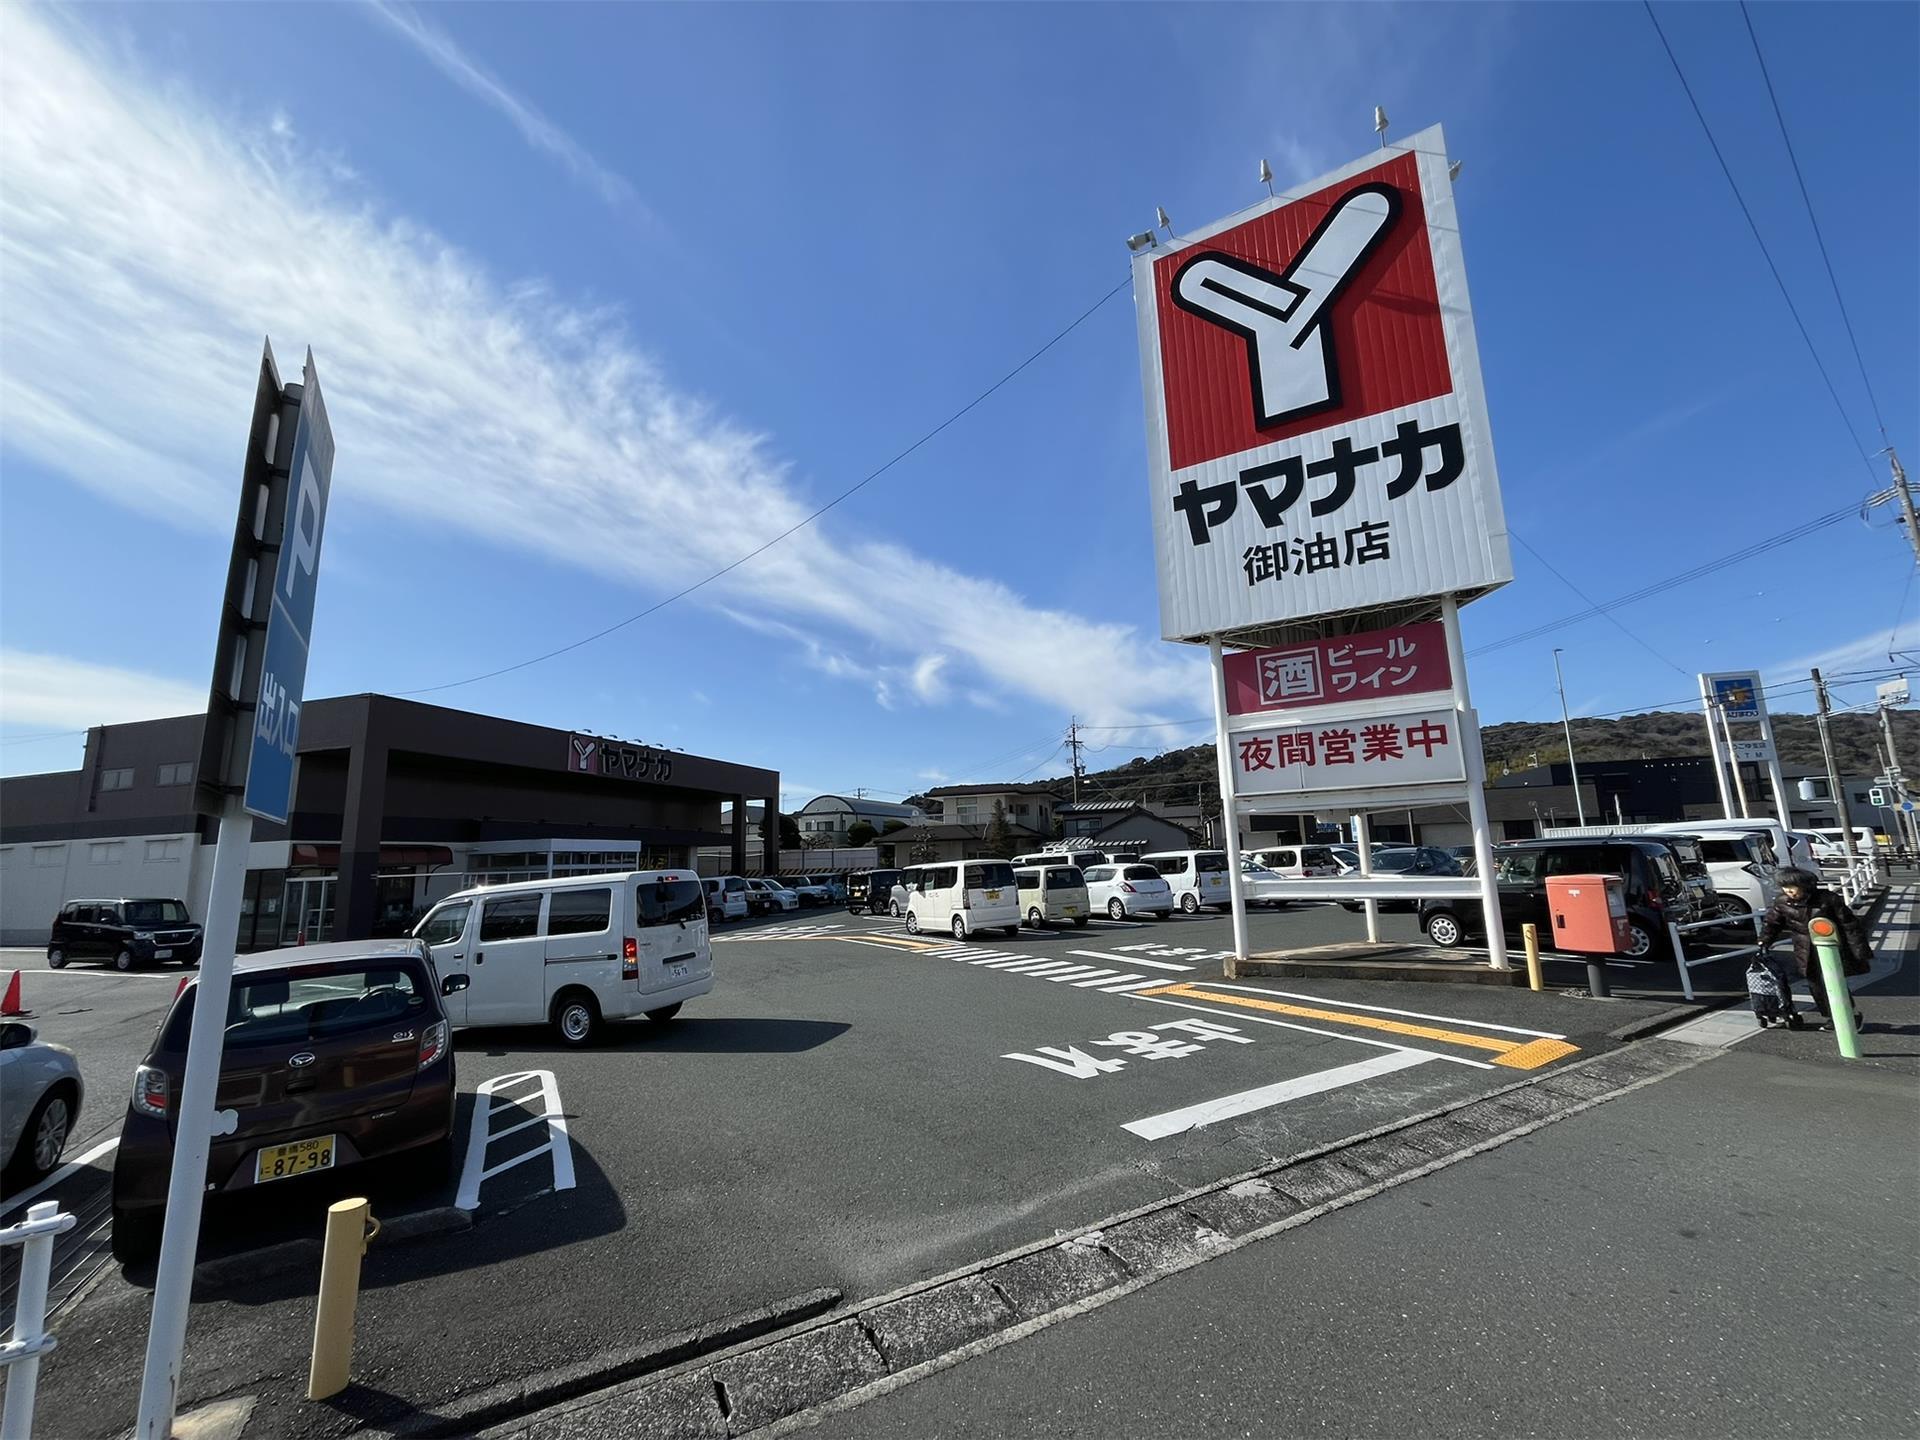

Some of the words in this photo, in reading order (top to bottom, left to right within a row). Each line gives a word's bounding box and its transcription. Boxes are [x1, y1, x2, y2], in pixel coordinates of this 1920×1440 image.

[1173, 420, 1466, 546] ヤマナカ
[285, 450, 322, 598] P
[1242, 520, 1391, 586] 御油店
[1263, 658, 1316, 698] 酒
[1327, 636, 1417, 668] ビール
[1331, 665, 1418, 693] ワイン
[256, 671, 300, 760] 出入口
[599, 743, 673, 782] ヤマナカ
[1238, 719, 1449, 773] 夜間営業中
[1001, 1018, 1255, 1080] 止まれ
[273, 1148, 331, 1176] 87-98
